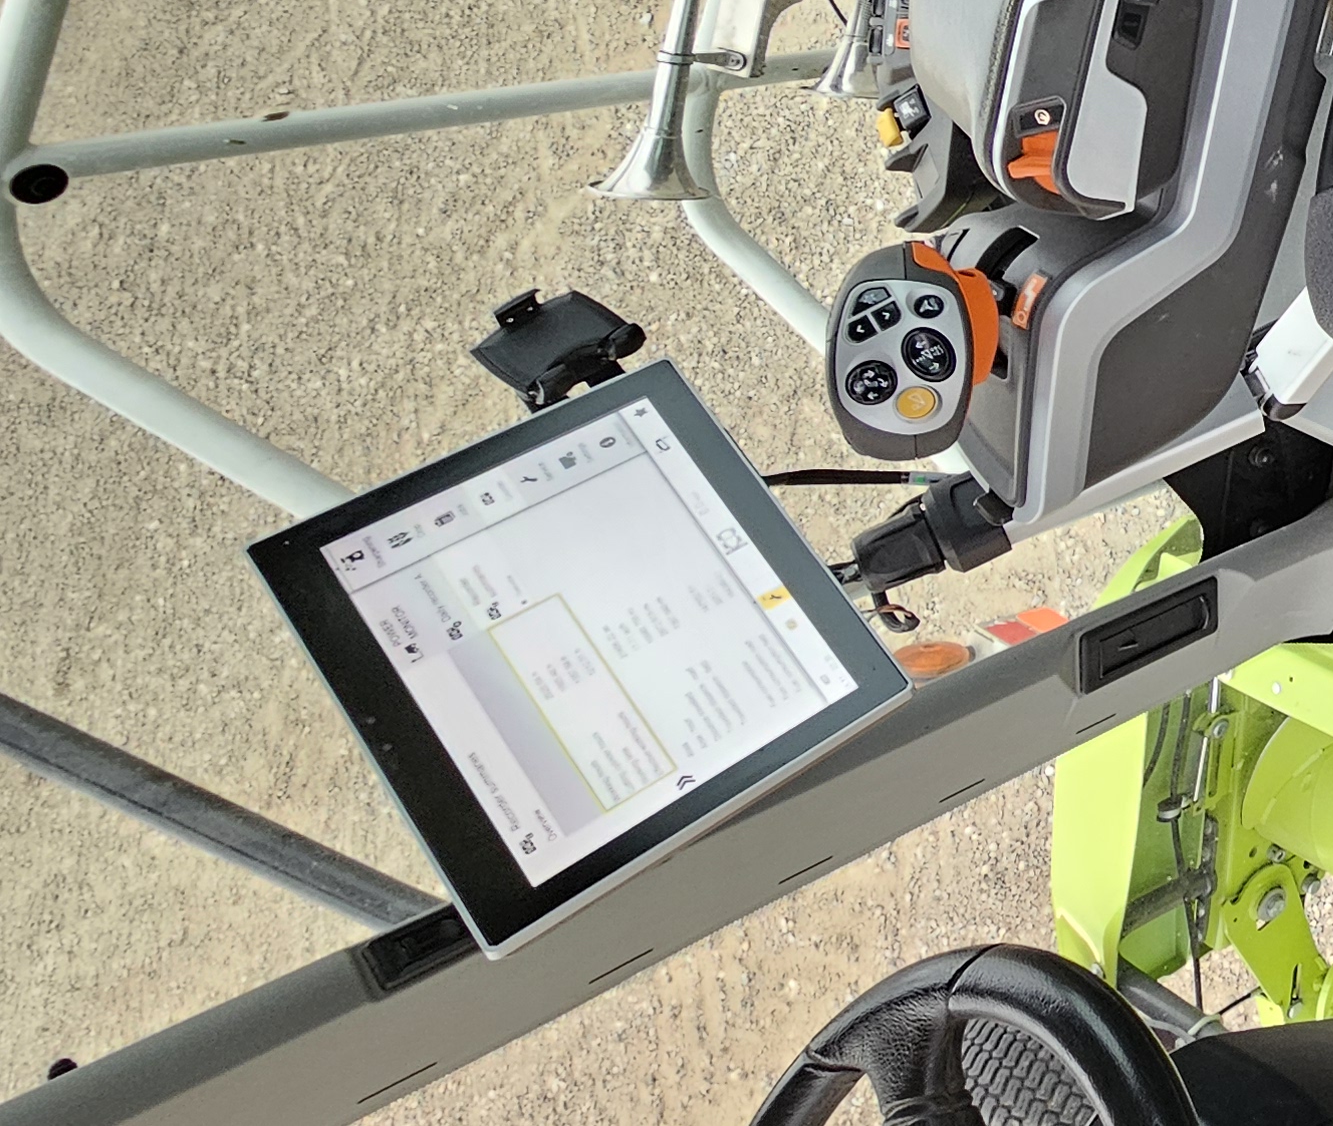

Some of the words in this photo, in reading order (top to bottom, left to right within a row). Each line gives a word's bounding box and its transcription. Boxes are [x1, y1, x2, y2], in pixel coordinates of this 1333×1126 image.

[378, 617, 404, 647] POWER
[389, 603, 420, 640] MONITOR
[491, 792, 523, 832] Recorder
[530, 807, 559, 842] Overview
